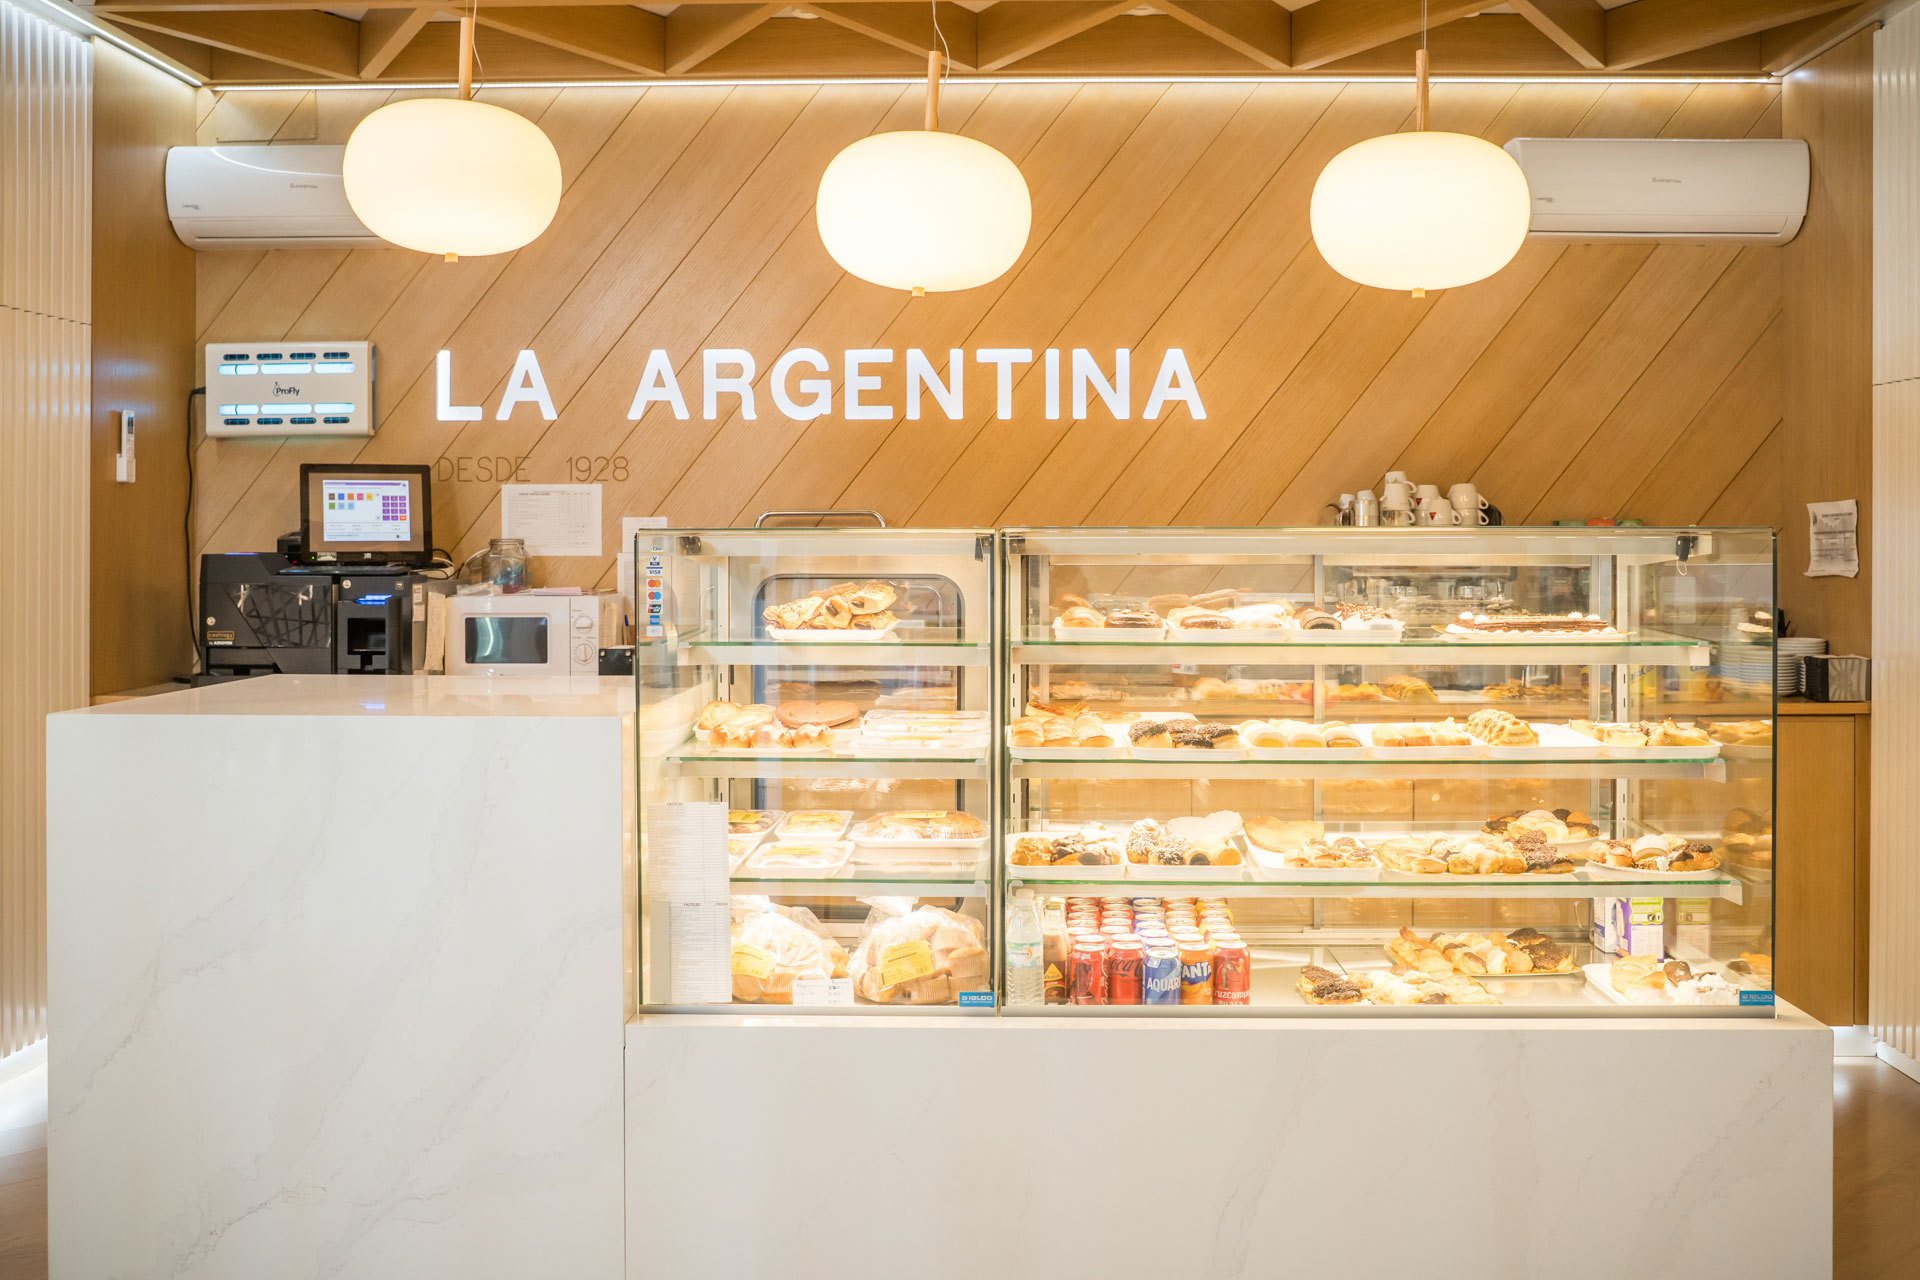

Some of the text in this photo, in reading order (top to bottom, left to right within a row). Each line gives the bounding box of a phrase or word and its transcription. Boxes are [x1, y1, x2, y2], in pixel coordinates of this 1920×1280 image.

[275, 386, 300, 396] ProFly
[436, 347, 1207, 421] LA ARGENTINA
[437, 456, 630, 482] DESDE 1928
[1181, 961, 1212, 979] ANTA
